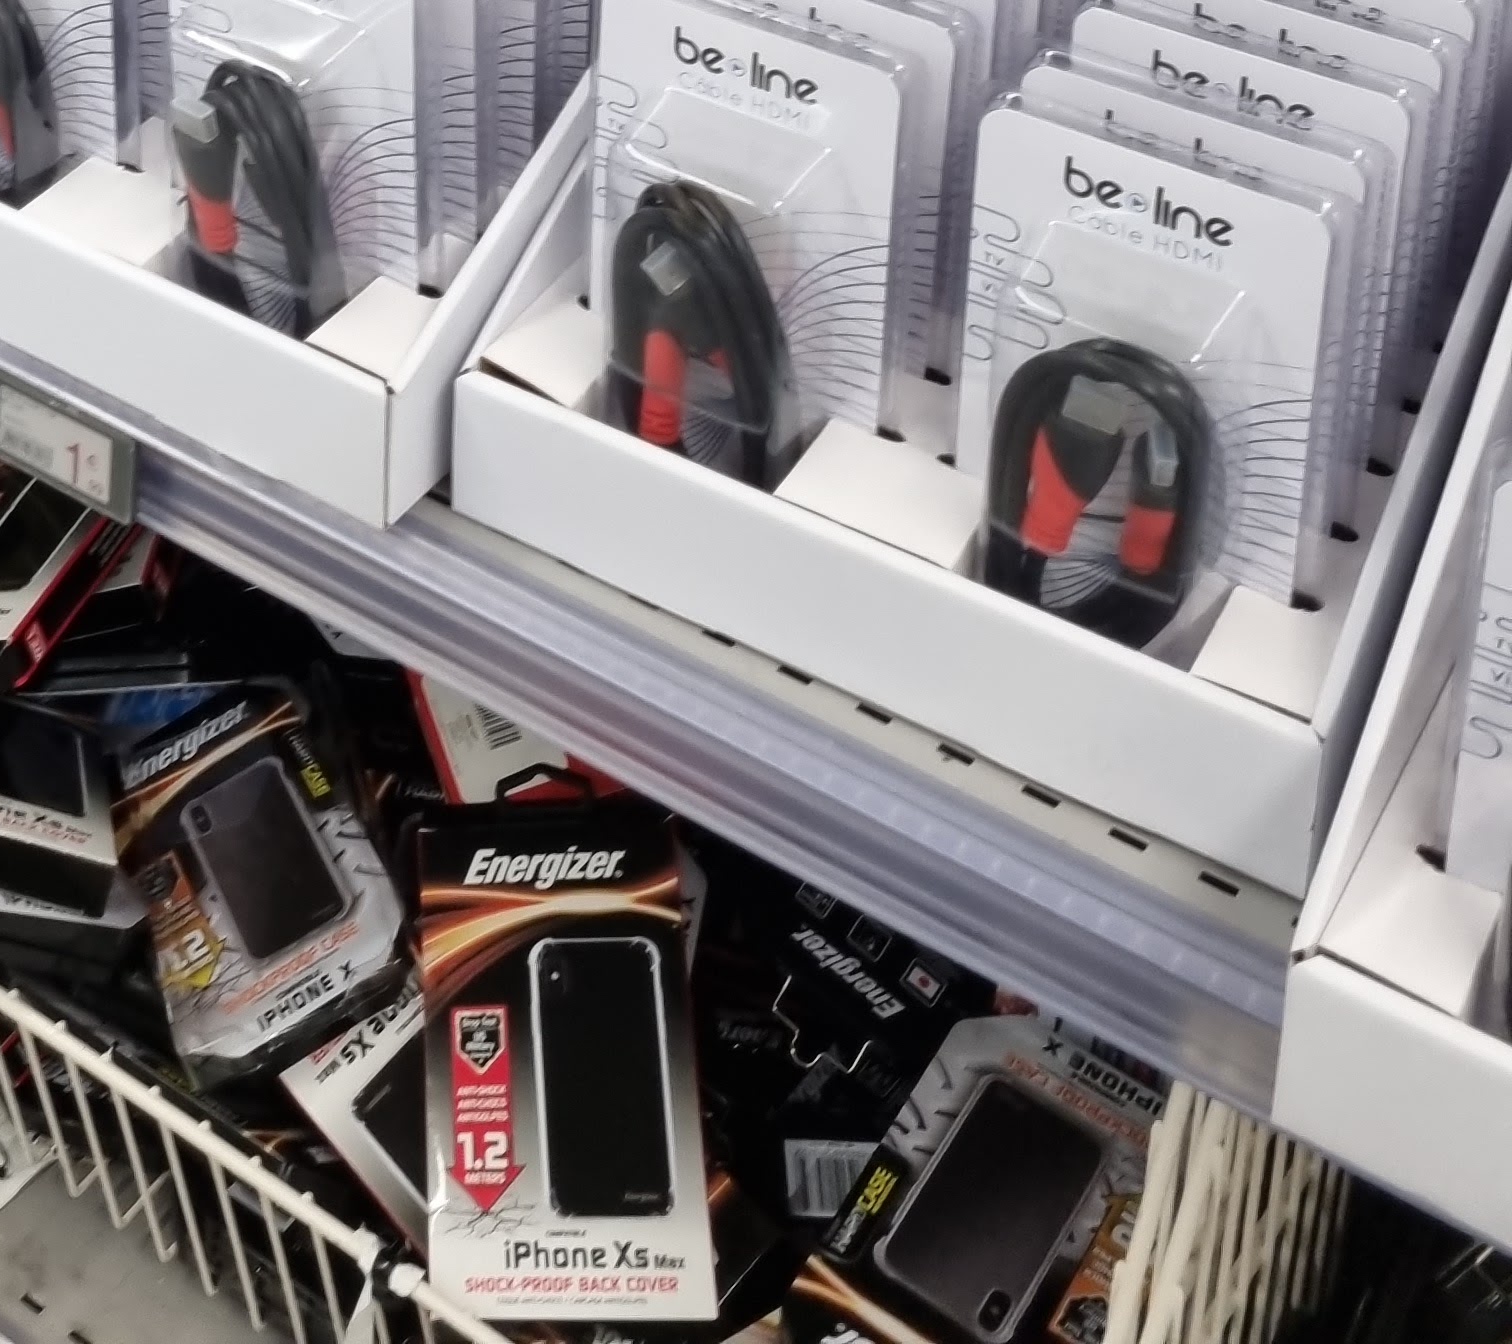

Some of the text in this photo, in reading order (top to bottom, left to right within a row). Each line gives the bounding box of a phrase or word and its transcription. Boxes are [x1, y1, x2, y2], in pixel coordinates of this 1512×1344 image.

[1152, 226, 1224, 272] HDMI
[464, 847, 627, 890] Energizer
[256, 972, 335, 1033] IPHONE
[337, 959, 353, 982] X
[457, 1131, 510, 1170] 1.2
[503, 1238, 606, 1270] iPhone
[612, 1239, 649, 1270] Xs
[464, 1275, 679, 1294] SHOCK-PROOF BACK COVER
